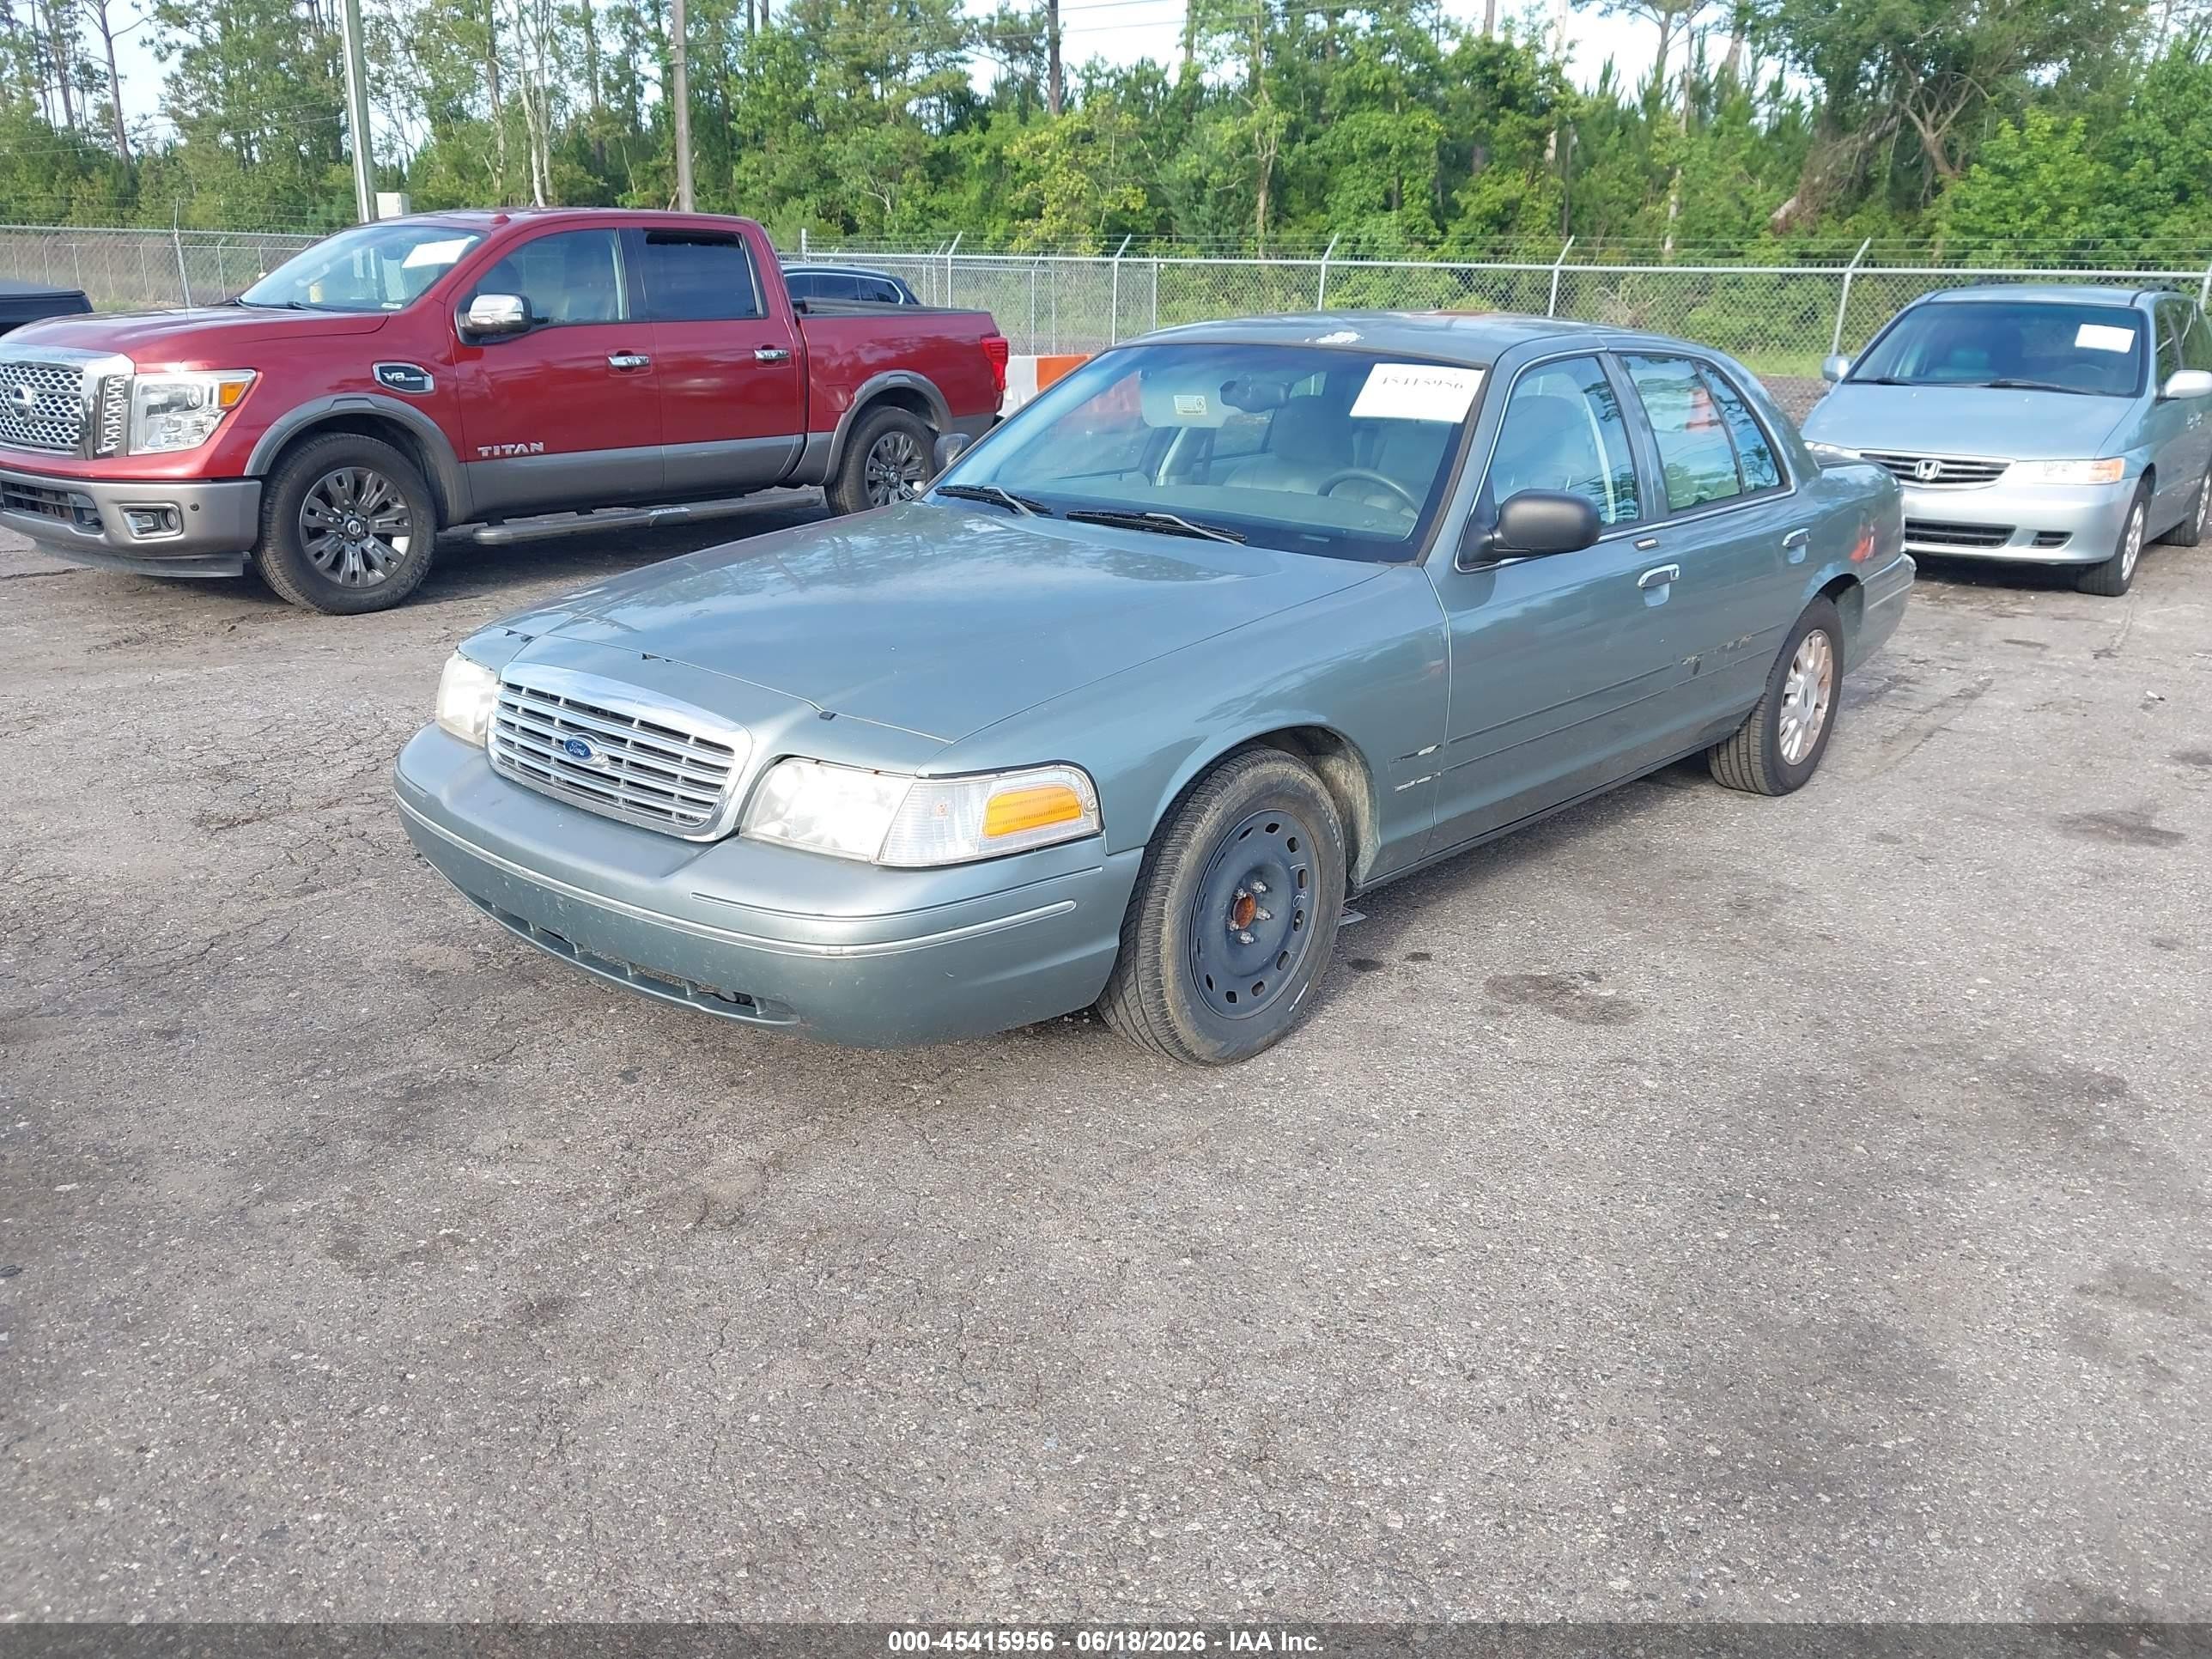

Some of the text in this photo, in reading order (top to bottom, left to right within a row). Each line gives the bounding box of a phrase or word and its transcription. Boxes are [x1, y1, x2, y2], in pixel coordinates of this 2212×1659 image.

[382, 372, 405, 382] V8
[477, 441, 544, 457] TITAN
[568, 741, 587, 757] Ford
